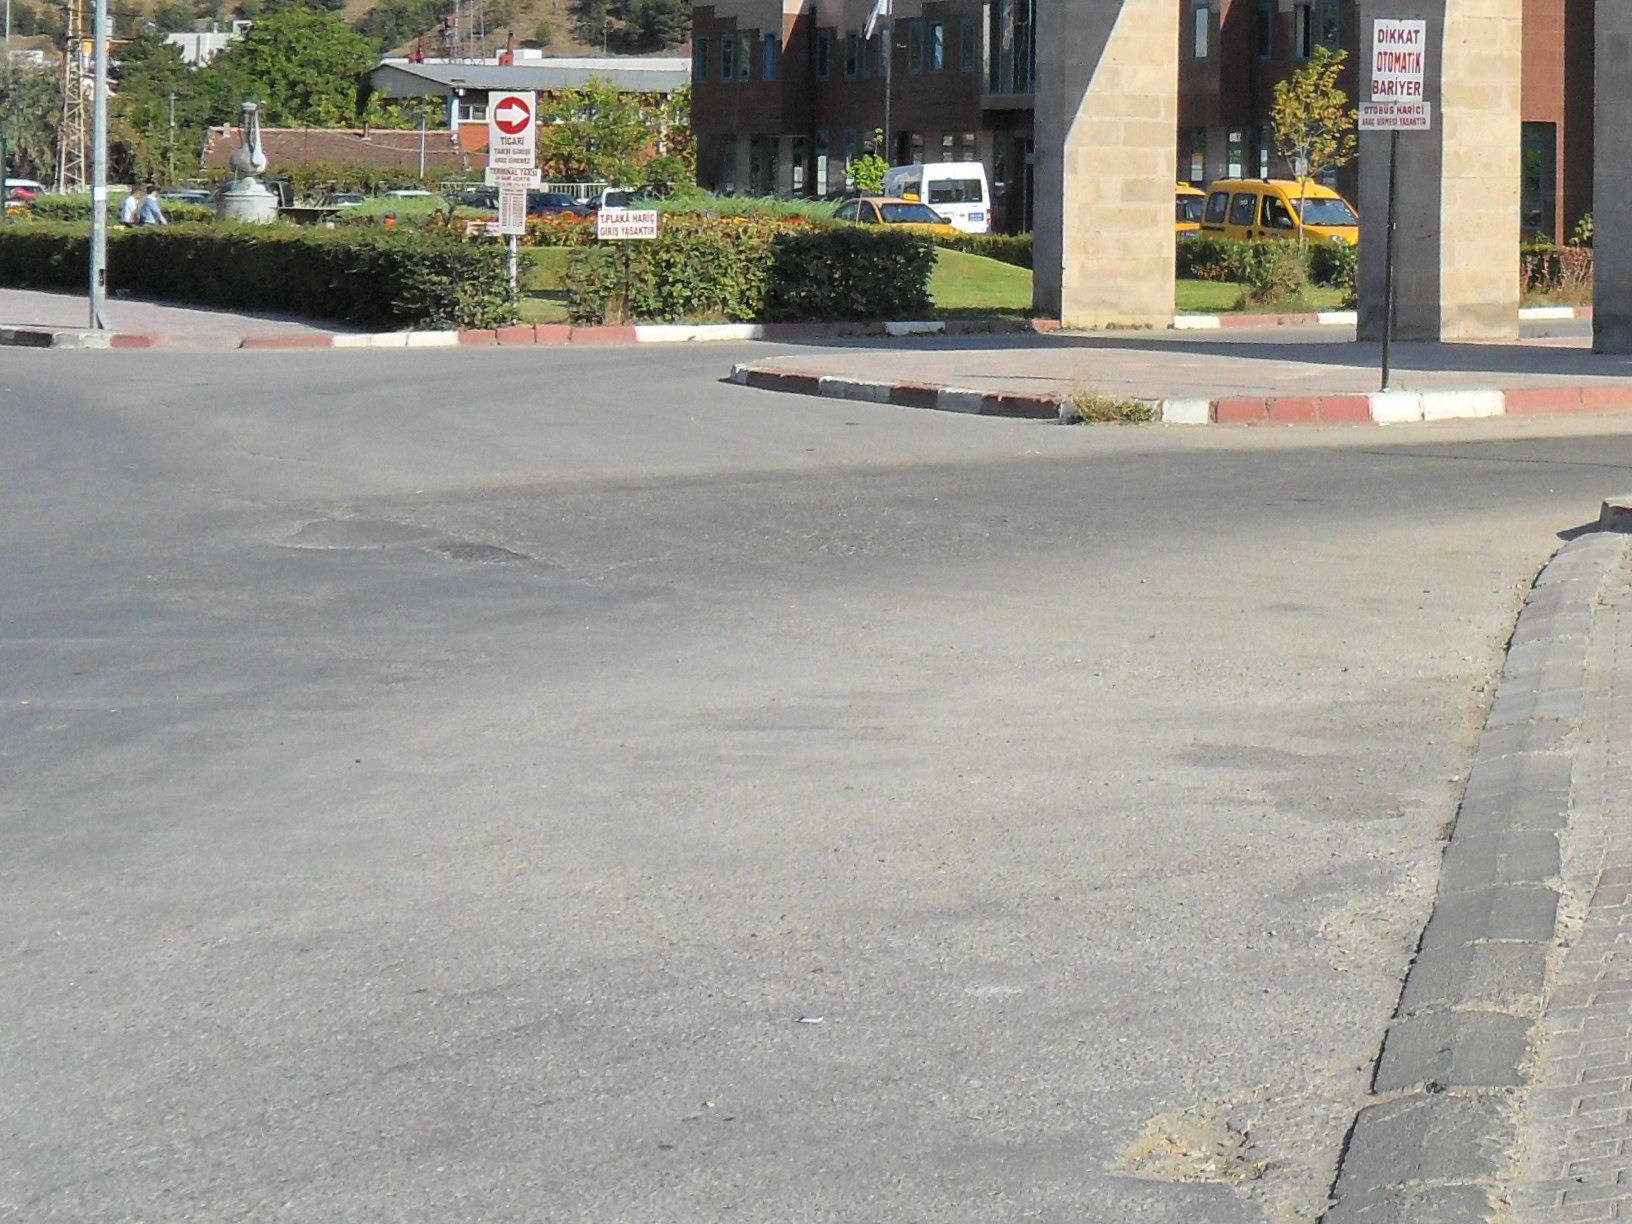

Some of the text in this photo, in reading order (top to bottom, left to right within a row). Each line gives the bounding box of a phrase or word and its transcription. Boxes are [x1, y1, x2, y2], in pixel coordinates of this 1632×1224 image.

[1378, 25, 1420, 44] DİKKAT
[1376, 51, 1421, 73] OTOMATİK
[1372, 77, 1421, 96] BARİYER
